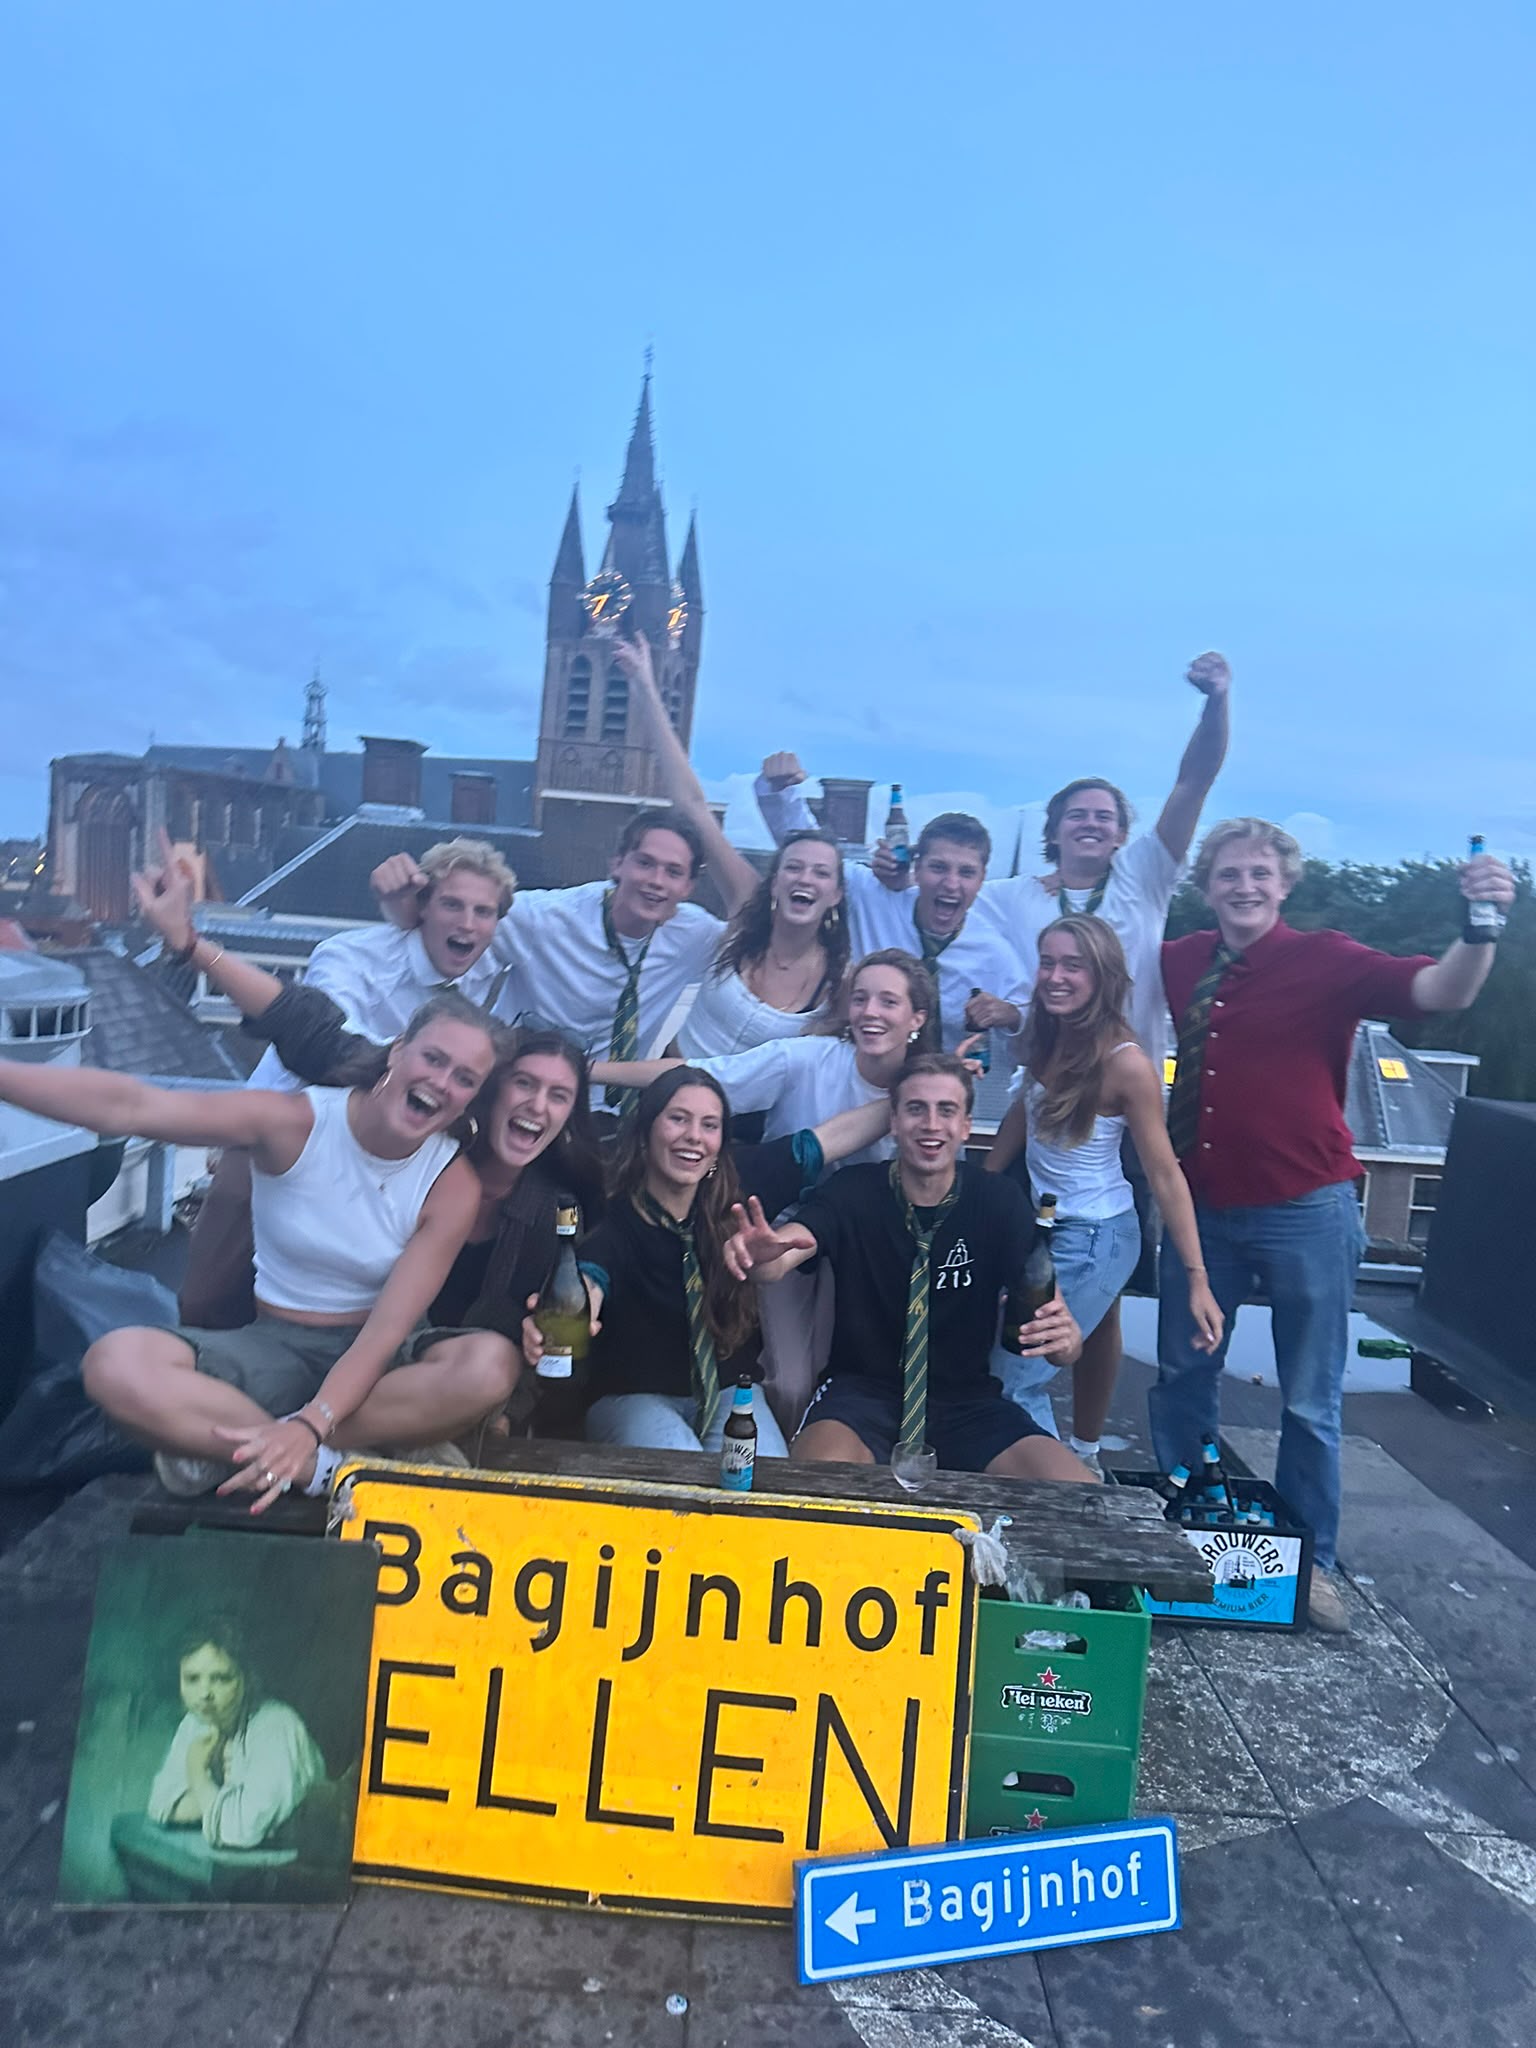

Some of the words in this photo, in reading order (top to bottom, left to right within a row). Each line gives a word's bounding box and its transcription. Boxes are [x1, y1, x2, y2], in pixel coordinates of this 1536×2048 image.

[363, 1519, 951, 1662] Bagijnhof
[1213, 1597, 1247, 1613] EMIUM
[368, 1658, 921, 1851] ELLEN
[903, 1850, 1142, 1933] Bagijnhof
